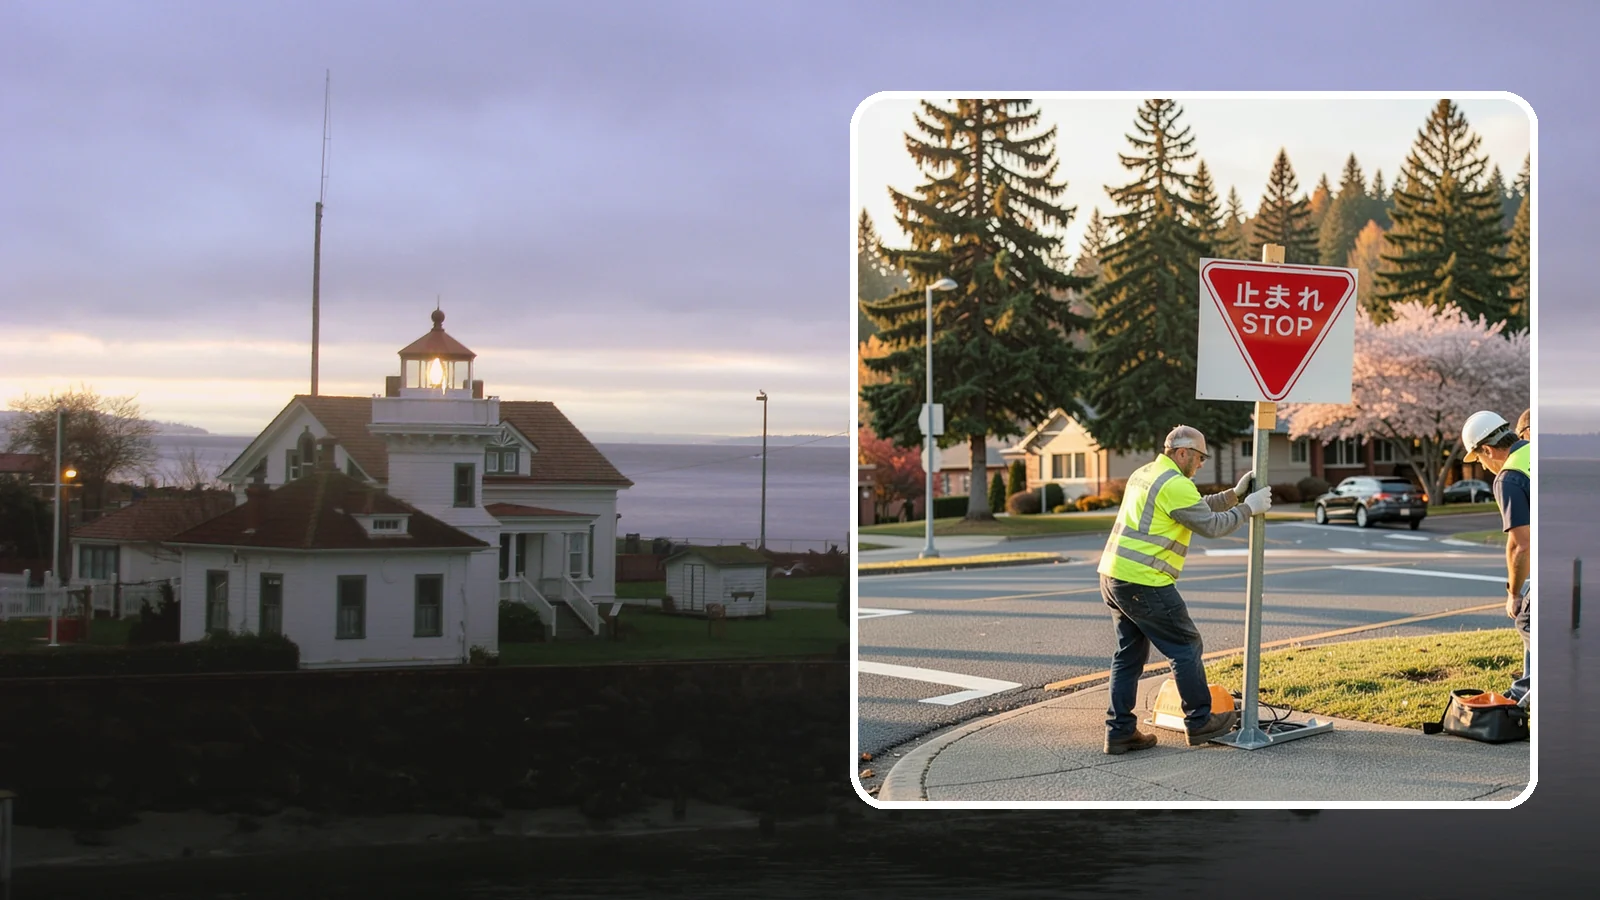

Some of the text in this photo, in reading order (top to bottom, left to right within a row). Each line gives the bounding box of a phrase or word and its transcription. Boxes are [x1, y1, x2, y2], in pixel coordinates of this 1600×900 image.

[1233, 281, 1325, 312] 止まれ
[1242, 313, 1313, 336] STOP
